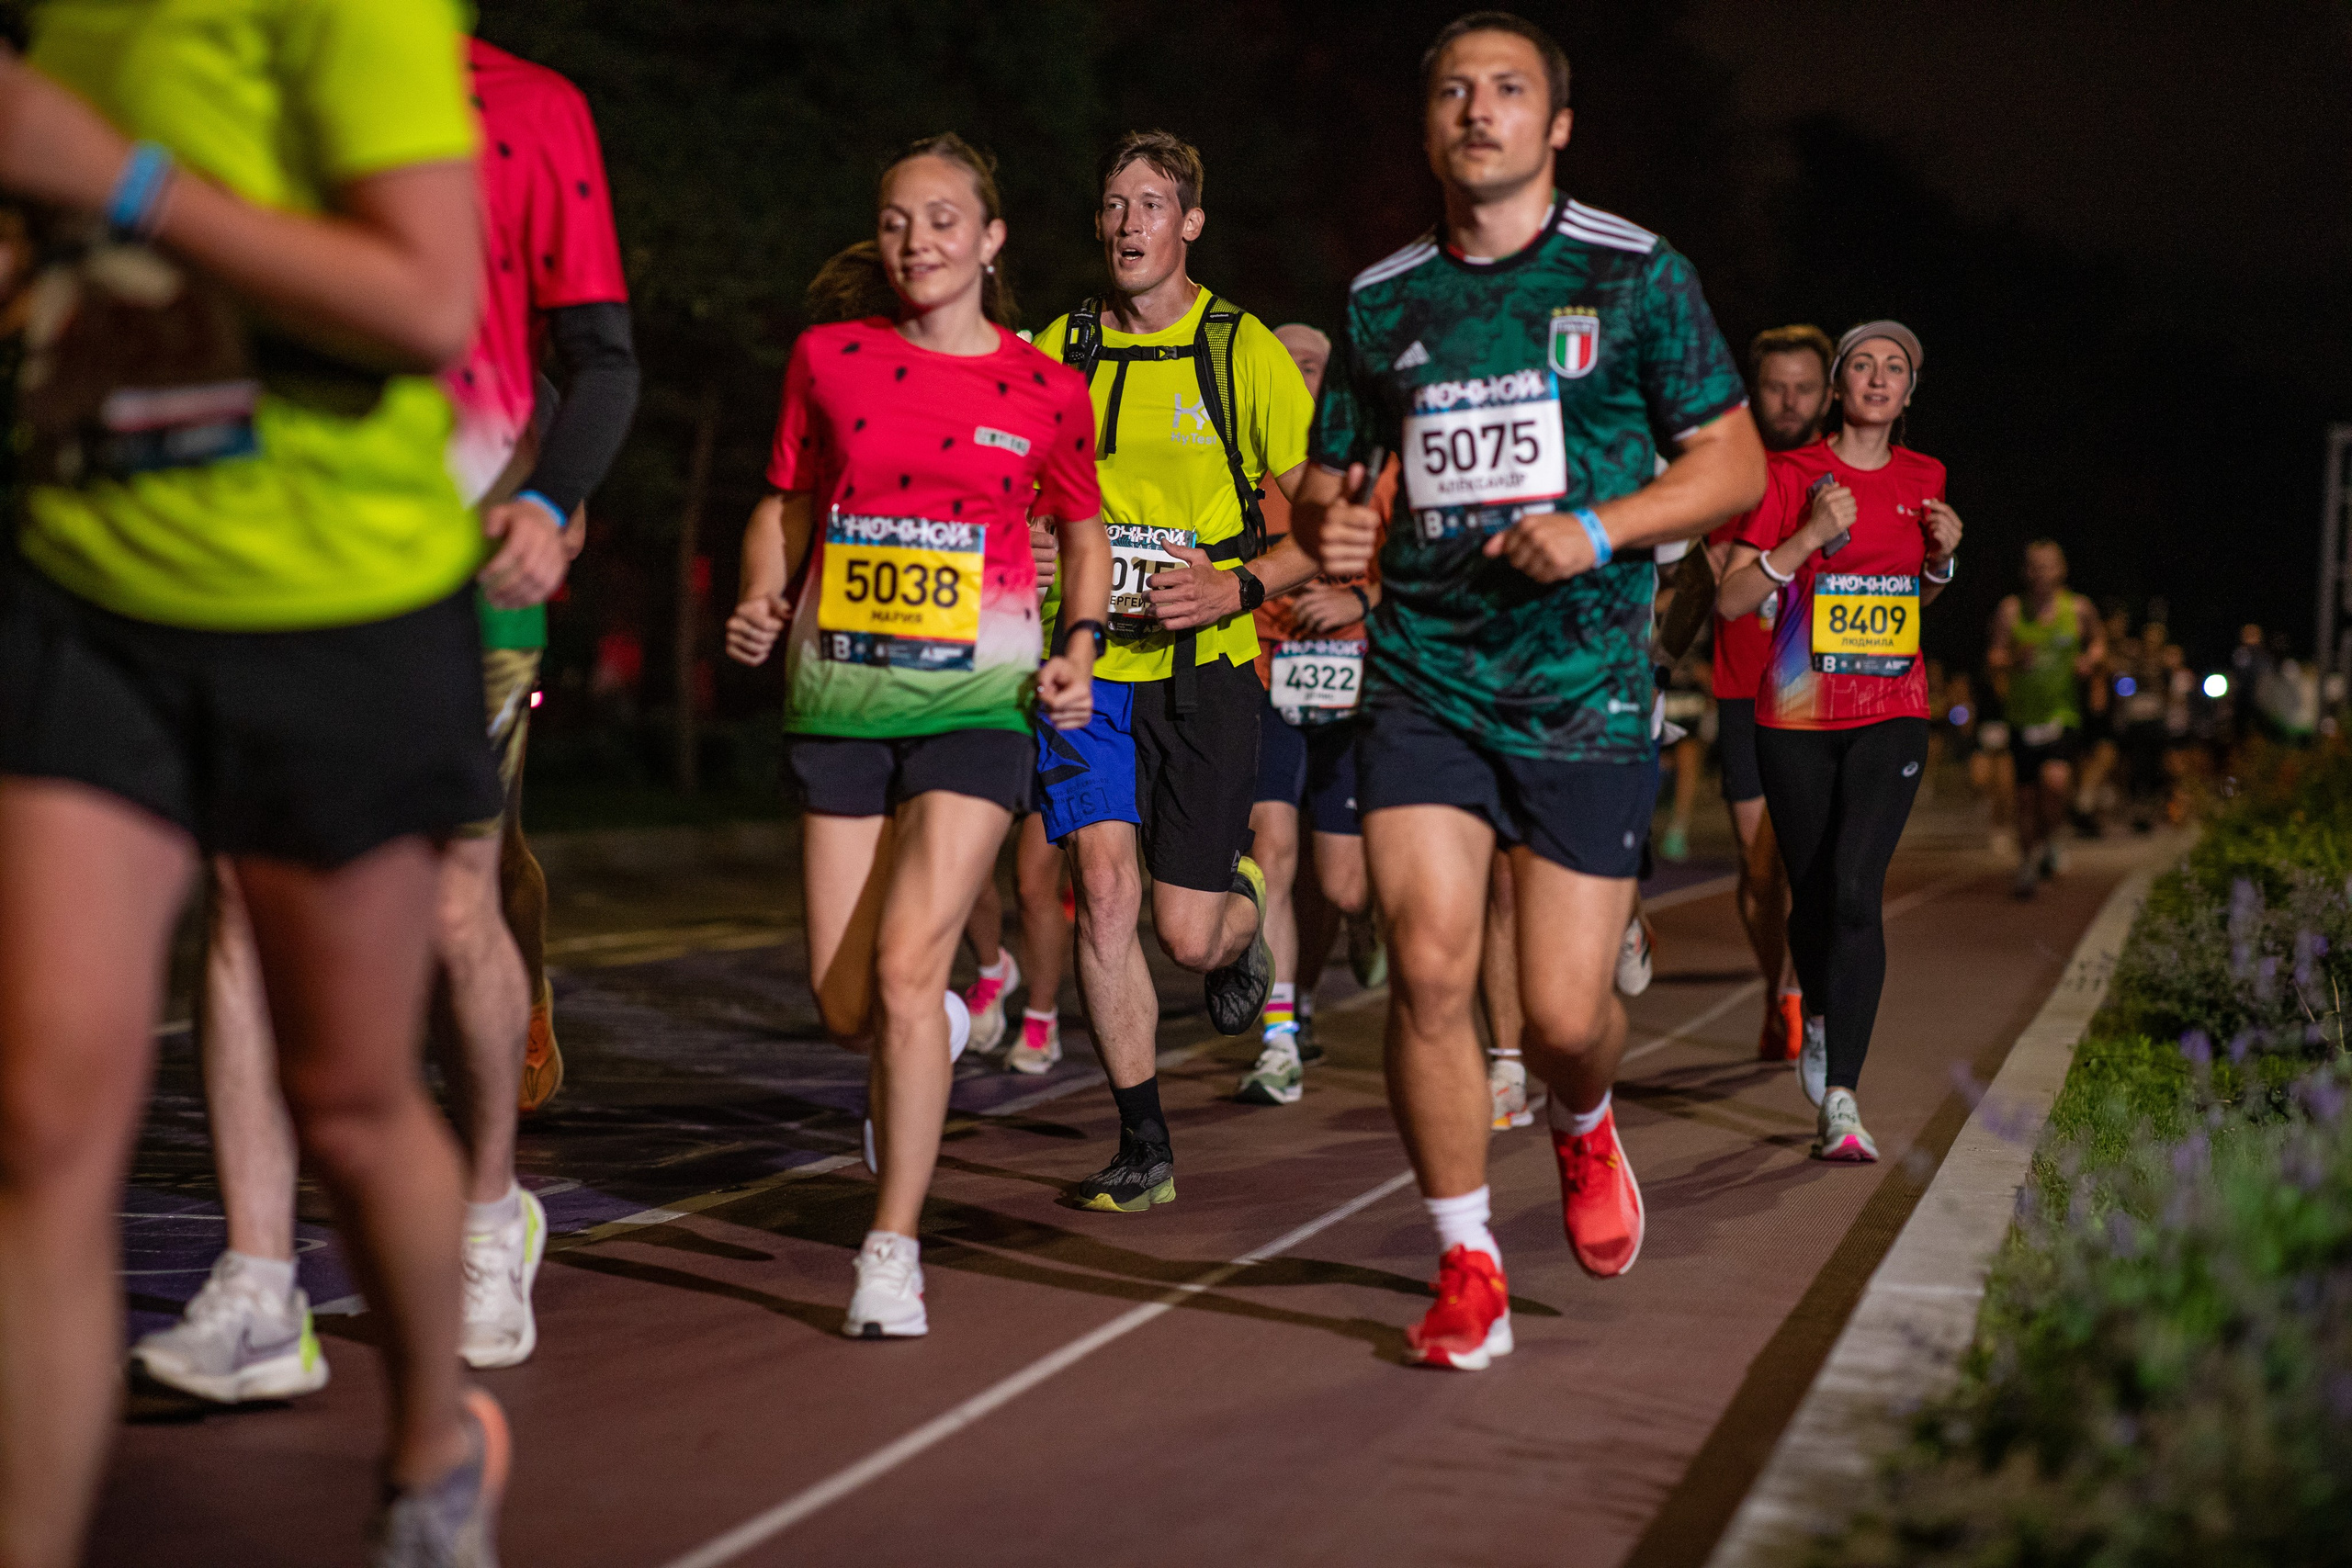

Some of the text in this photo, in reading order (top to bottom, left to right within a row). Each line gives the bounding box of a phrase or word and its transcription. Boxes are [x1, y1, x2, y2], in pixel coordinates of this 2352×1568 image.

[1421, 420, 1539, 475] 5075
[1103, 525, 1186, 547] ОЧНОЙ
[845, 559, 960, 608] 5038
[1110, 595, 1147, 608] ЕРГЕЙ
[1829, 604, 1906, 635] 8409
[1841, 637, 1894, 647] ЛЮДМИЛА
[1286, 664, 1354, 690] 4322
